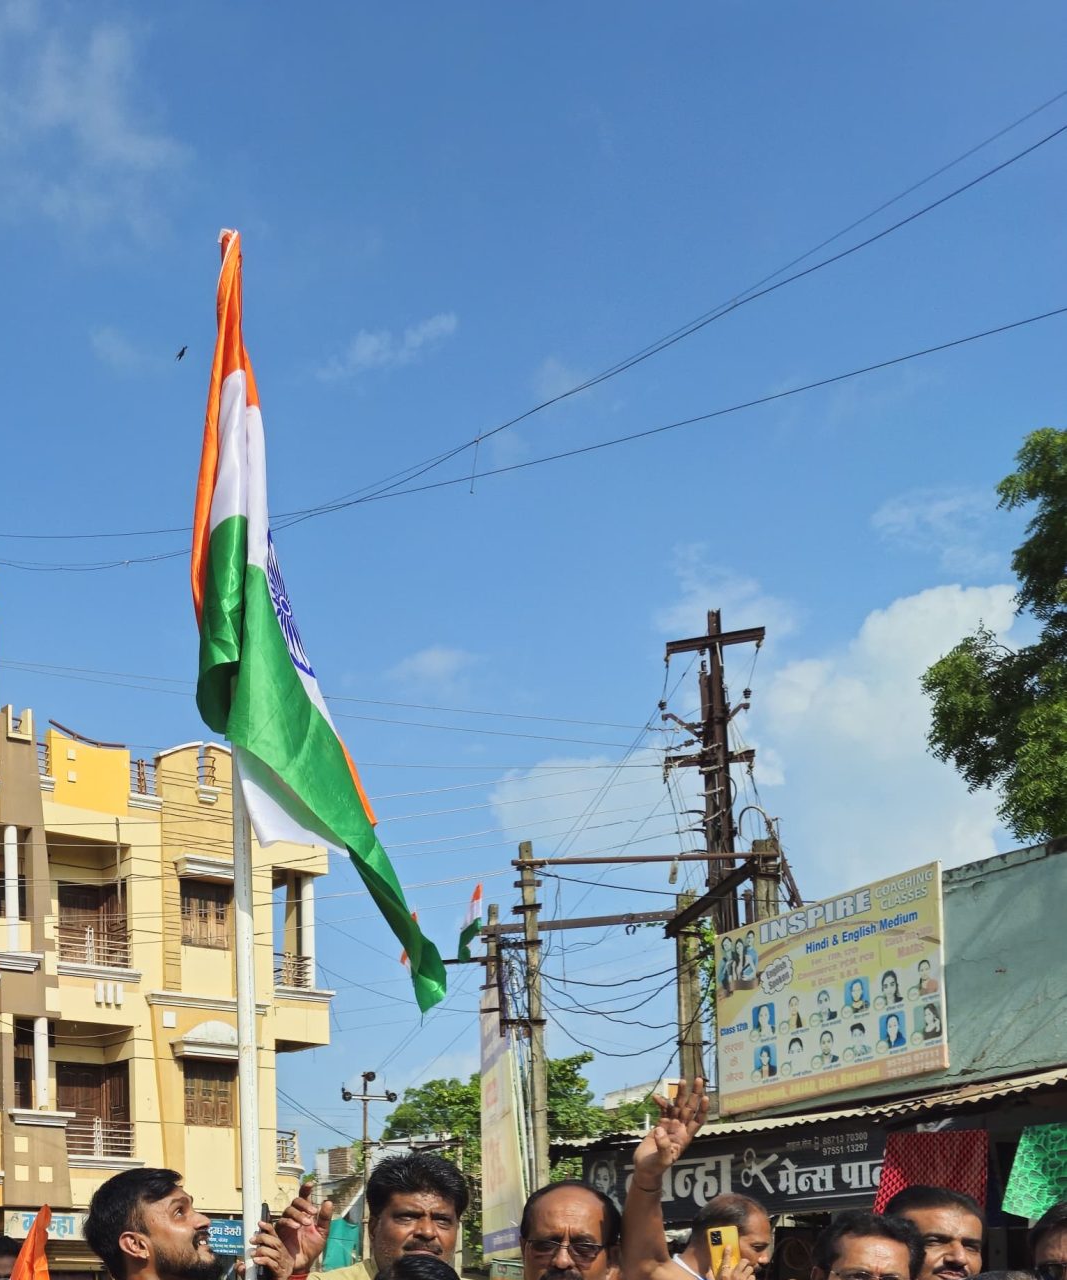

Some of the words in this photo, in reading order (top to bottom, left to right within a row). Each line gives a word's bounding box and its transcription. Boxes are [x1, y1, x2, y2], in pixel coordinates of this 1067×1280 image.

[874, 870, 934, 899] COACHING
[879, 885, 929, 911] CLASSES
[760, 889, 872, 945] INSPIRE
[805, 937, 829, 954] Hindi
[832, 934, 839, 946] &
[842, 922, 877, 944] English
[879, 911, 918, 930] Medium
[822, 1146, 844, 1157] 97551
[846, 1142, 868, 1153] 13297
[624, 1154, 735, 1208] ान्हा
[778, 1158, 836, 1195] मेन्स
